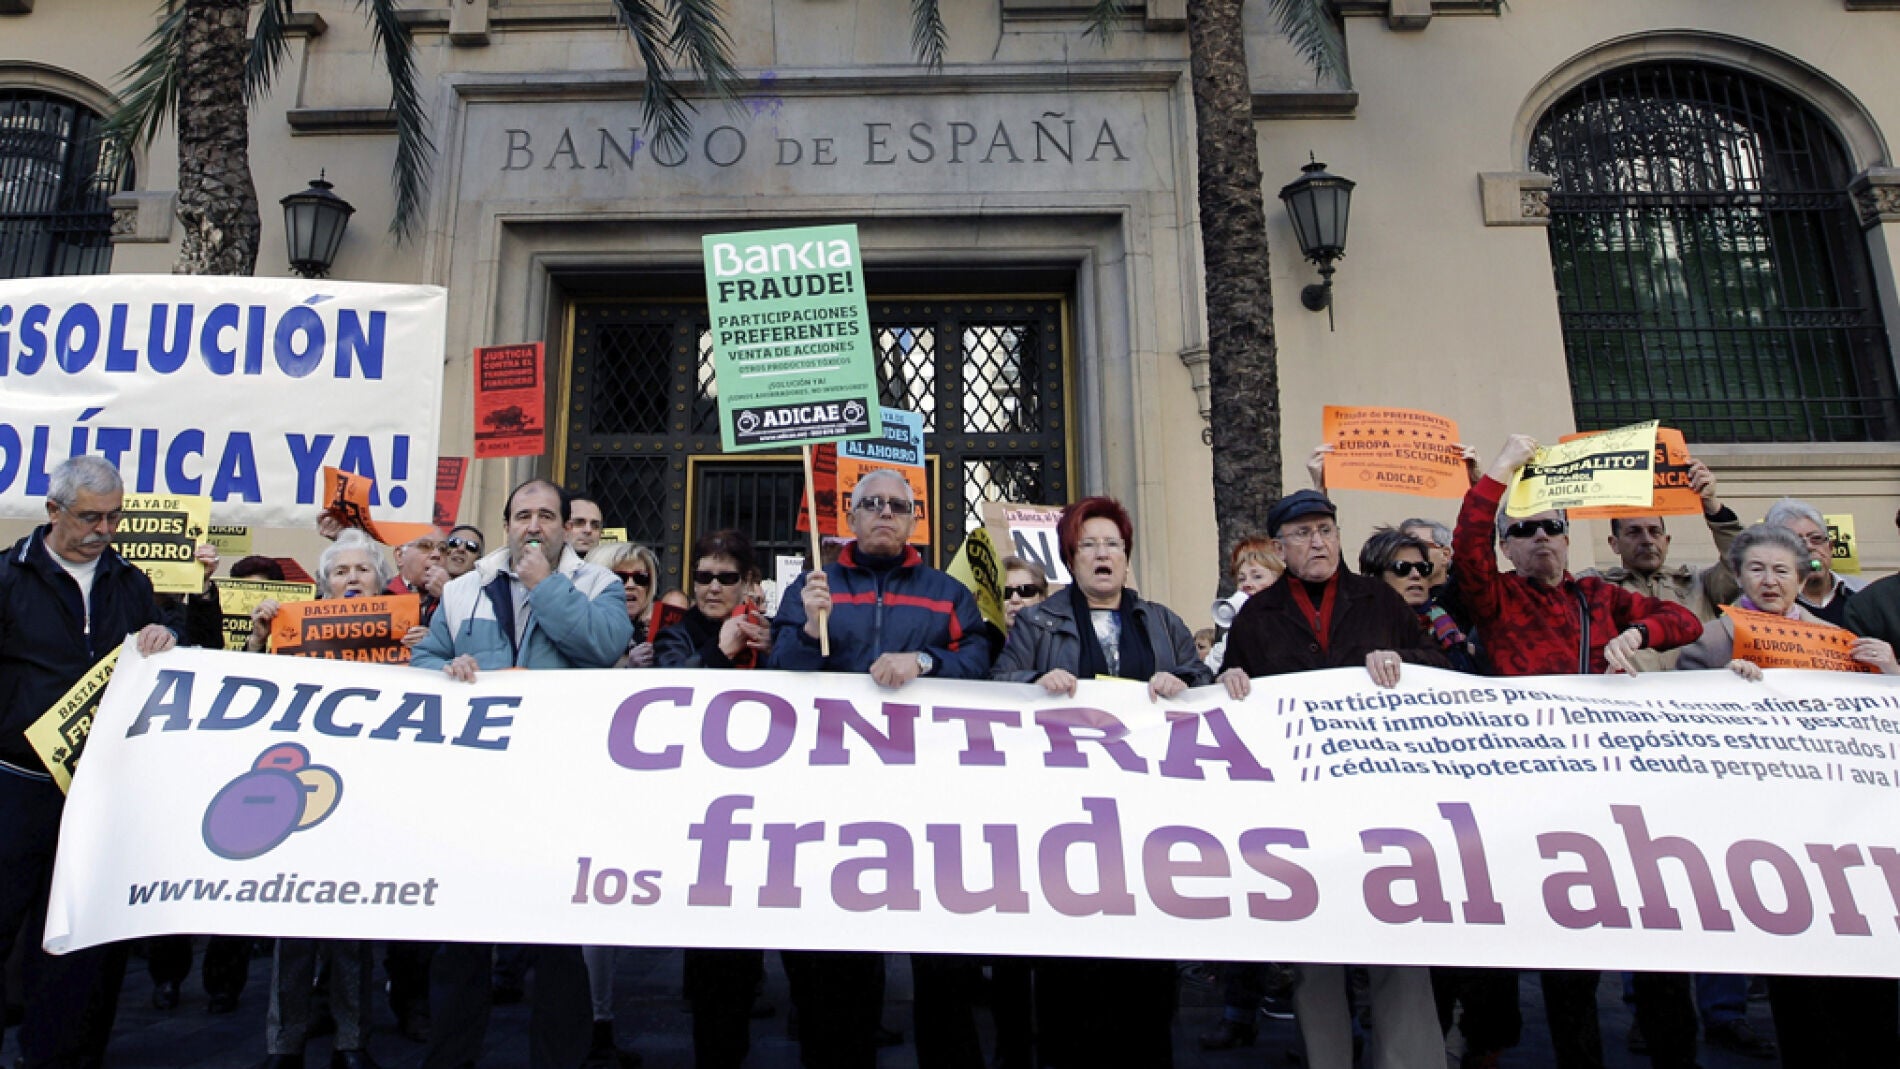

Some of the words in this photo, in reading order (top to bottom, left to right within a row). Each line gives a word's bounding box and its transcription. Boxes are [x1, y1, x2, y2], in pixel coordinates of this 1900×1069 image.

[501, 125, 747, 171] BANCO
[775, 137, 838, 166] DE
[863, 111, 1131, 166] ESPAÑA
[713, 239, 853, 277] Bankia
[717, 271, 854, 303] FRAUDE!
[718, 304, 859, 328] PARTICIPACIONES
[0, 294, 387, 380] ¡SOLUCIÓN
[720, 320, 860, 346] PREFERENTES
[728, 349, 772, 361] VENTA
[775, 345, 792, 357] DE
[794, 341, 855, 355] ACCIONES
[763, 404, 840, 428] ADICAE
[849, 441, 865, 454] AL
[866, 445, 916, 462] AHORRO
[1340, 440, 1391, 450] EUROPA
[0, 407, 262, 502] OLÍTICA
[286, 433, 411, 508] YA!
[1395, 449, 1461, 467] ESCUCHAR
[1376, 472, 1424, 486] ADICAE
[1655, 471, 1691, 485] NCA
[1548, 484, 1588, 497] ADICAE
[144, 499, 157, 509] YA
[116, 517, 184, 534] AUDES
[304, 604, 347, 617] BASTA
[351, 602, 369, 613] YA
[371, 601, 388, 612] DE
[305, 620, 388, 641] ABUSOS
[341, 647, 411, 664] BANCA
[1753, 638, 1805, 654] EUROPA
[57, 680, 98, 720] BASTA
[124, 669, 524, 751] ADICAE
[1304, 687, 1498, 713] participaciones
[606, 686, 1276, 782] CONTRA
[1310, 716, 1378, 732] banif
[1321, 737, 1401, 756] deuda
[1403, 733, 1568, 754] subordinada
[1598, 730, 1720, 752] depósitos
[1723, 732, 1886, 760] estructurados
[1329, 757, 1431, 777] cédulas
[1431, 756, 1598, 779] hipotecarias
[1629, 755, 1709, 774] deuda
[1710, 759, 1823, 781] perpetua
[1849, 766, 1891, 787] ava
[571, 856, 663, 905] los
[687, 794, 1320, 922] fraudes
[1358, 802, 1506, 926] al
[128, 873, 439, 907] www.adicae.net
